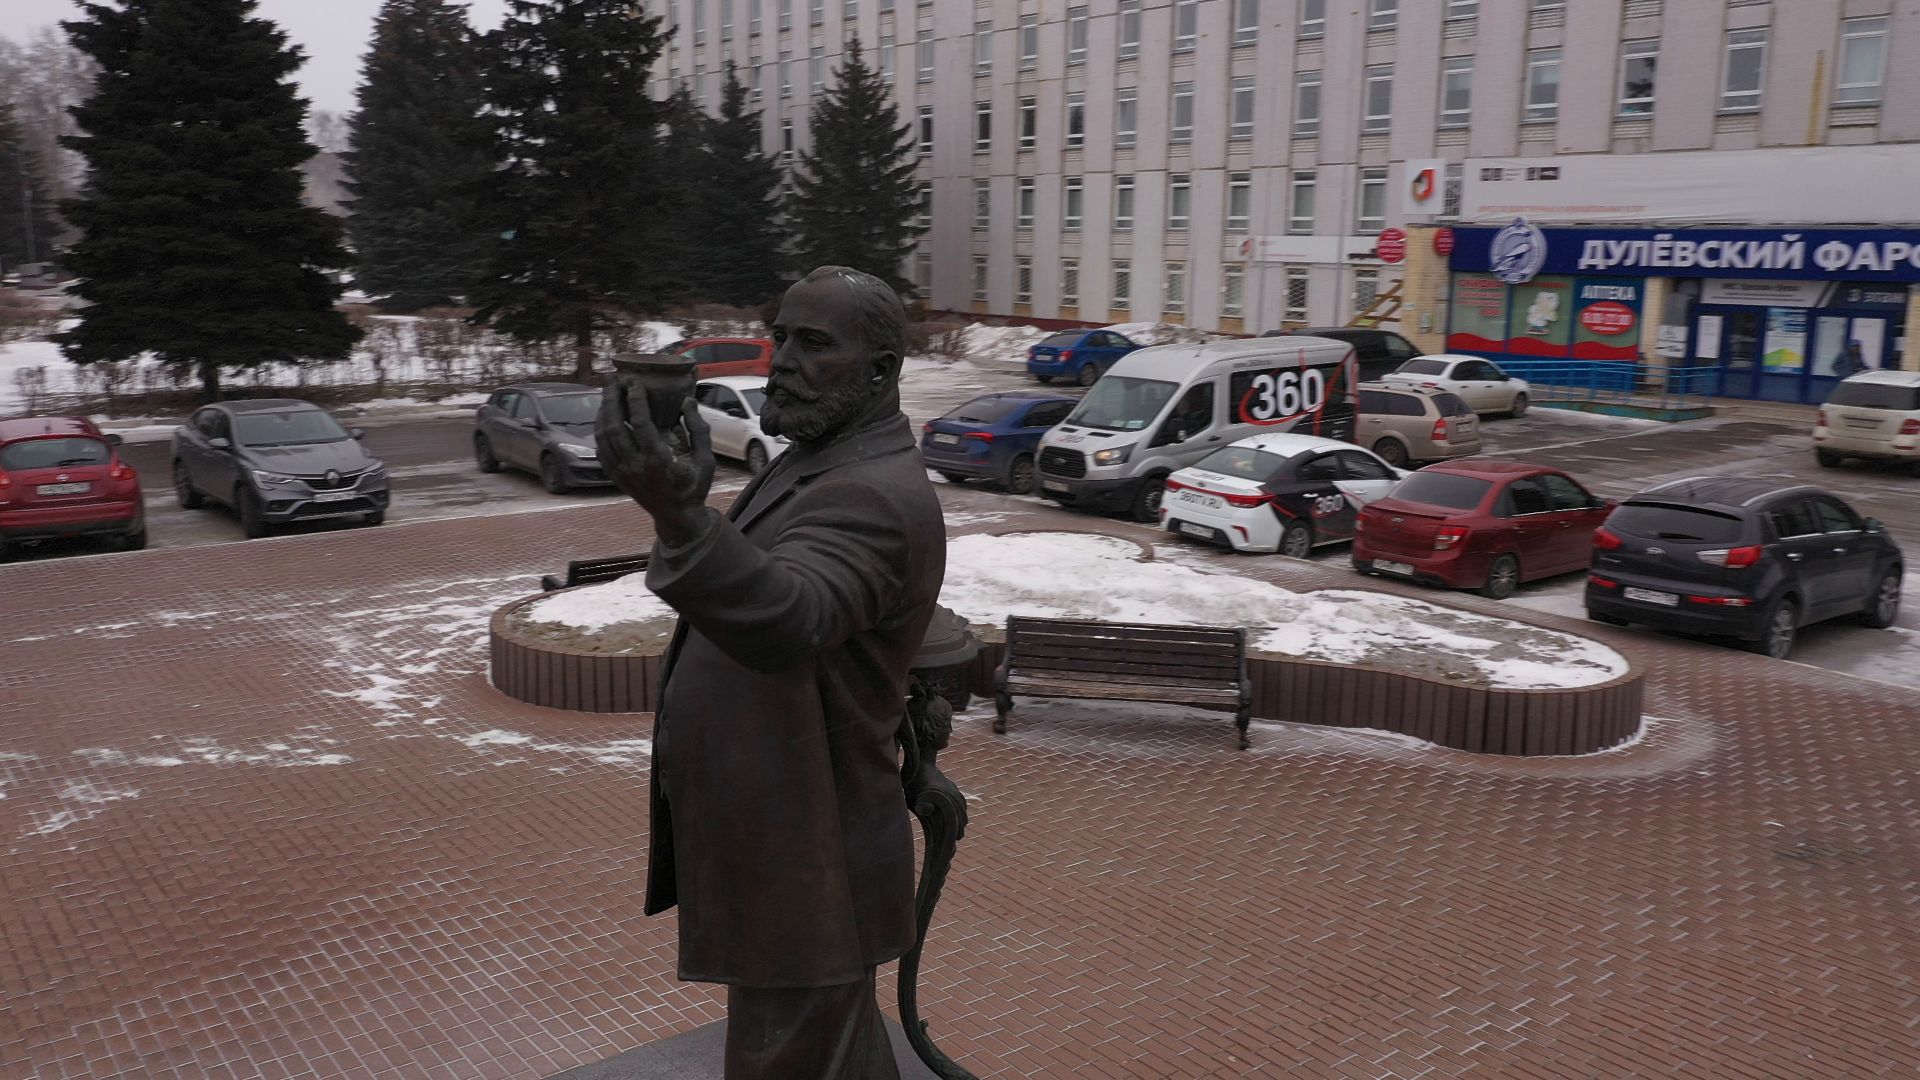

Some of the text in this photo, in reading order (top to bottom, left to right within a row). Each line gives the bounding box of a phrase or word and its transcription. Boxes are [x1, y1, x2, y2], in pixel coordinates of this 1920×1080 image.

[1577, 233, 1806, 271] ДУЛЁВСКИЙ
[1580, 284, 1636, 301] АПТЕКА
[1251, 368, 1325, 420] 360
[1315, 493, 1344, 515] 360
